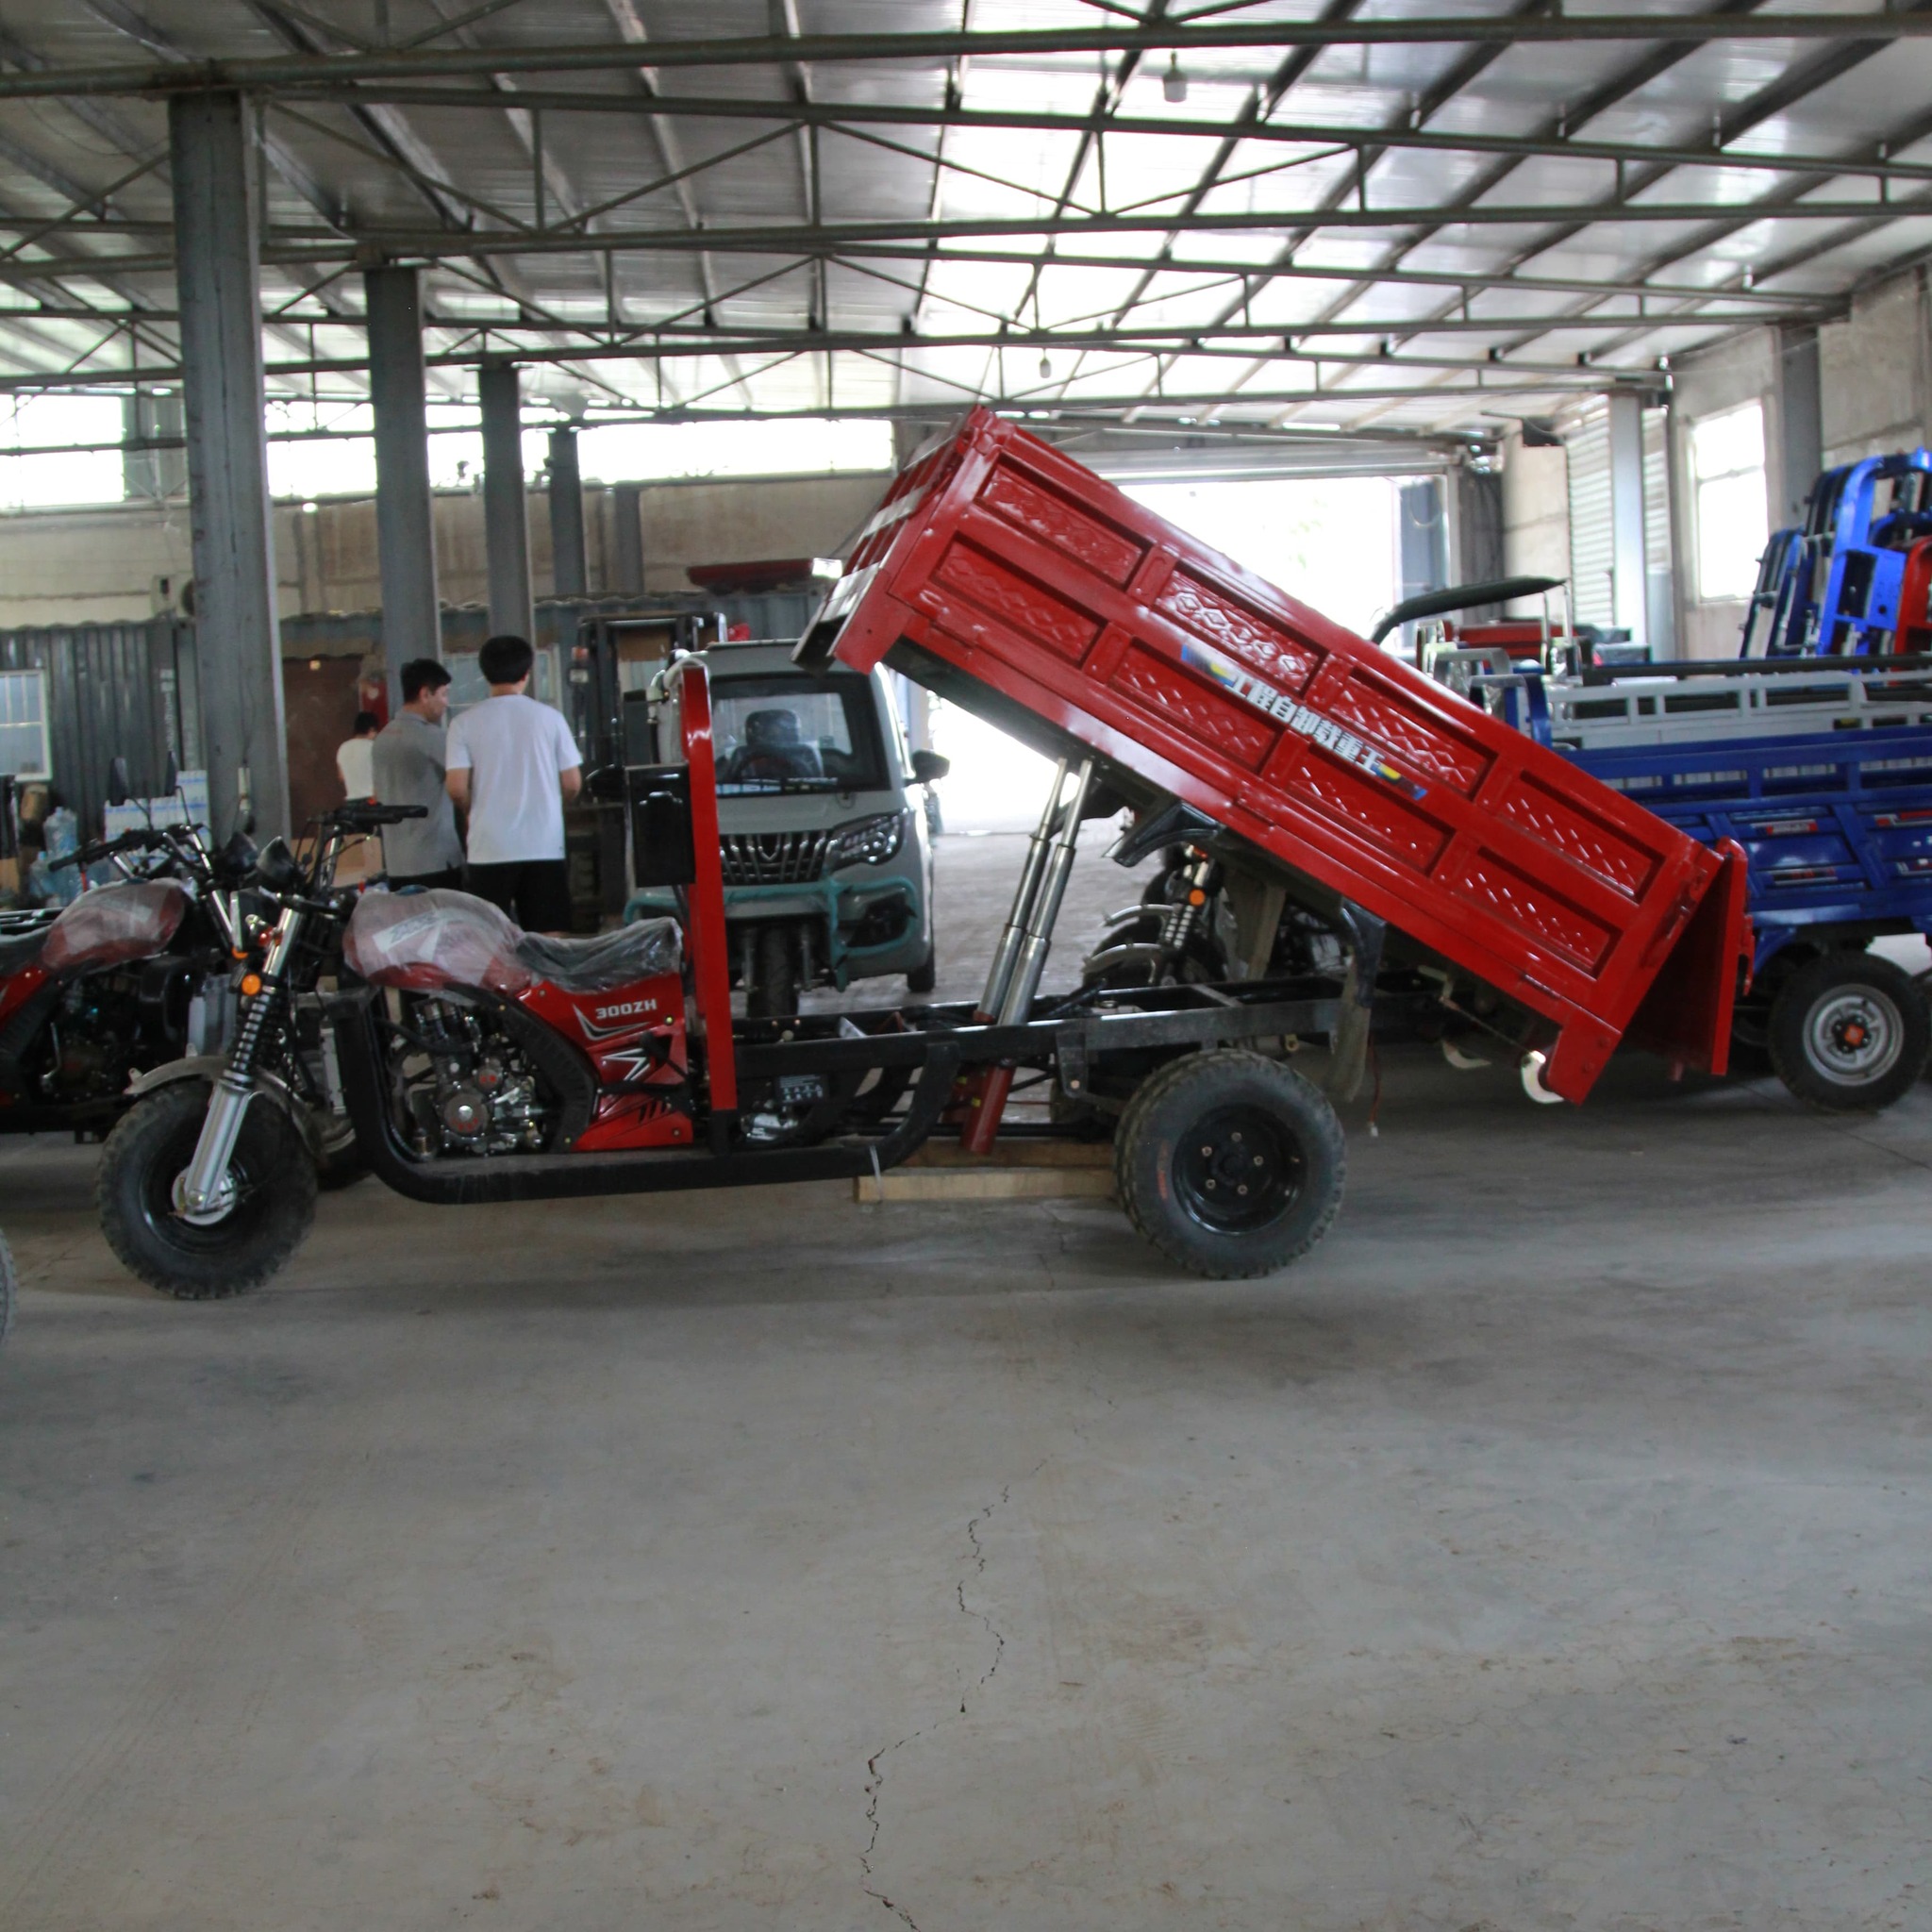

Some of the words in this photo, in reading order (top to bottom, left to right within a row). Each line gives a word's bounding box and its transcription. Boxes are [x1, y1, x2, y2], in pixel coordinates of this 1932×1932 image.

[1225, 672, 1384, 774] 工程自卸载重王
[595, 999, 657, 1019] 300ZH
